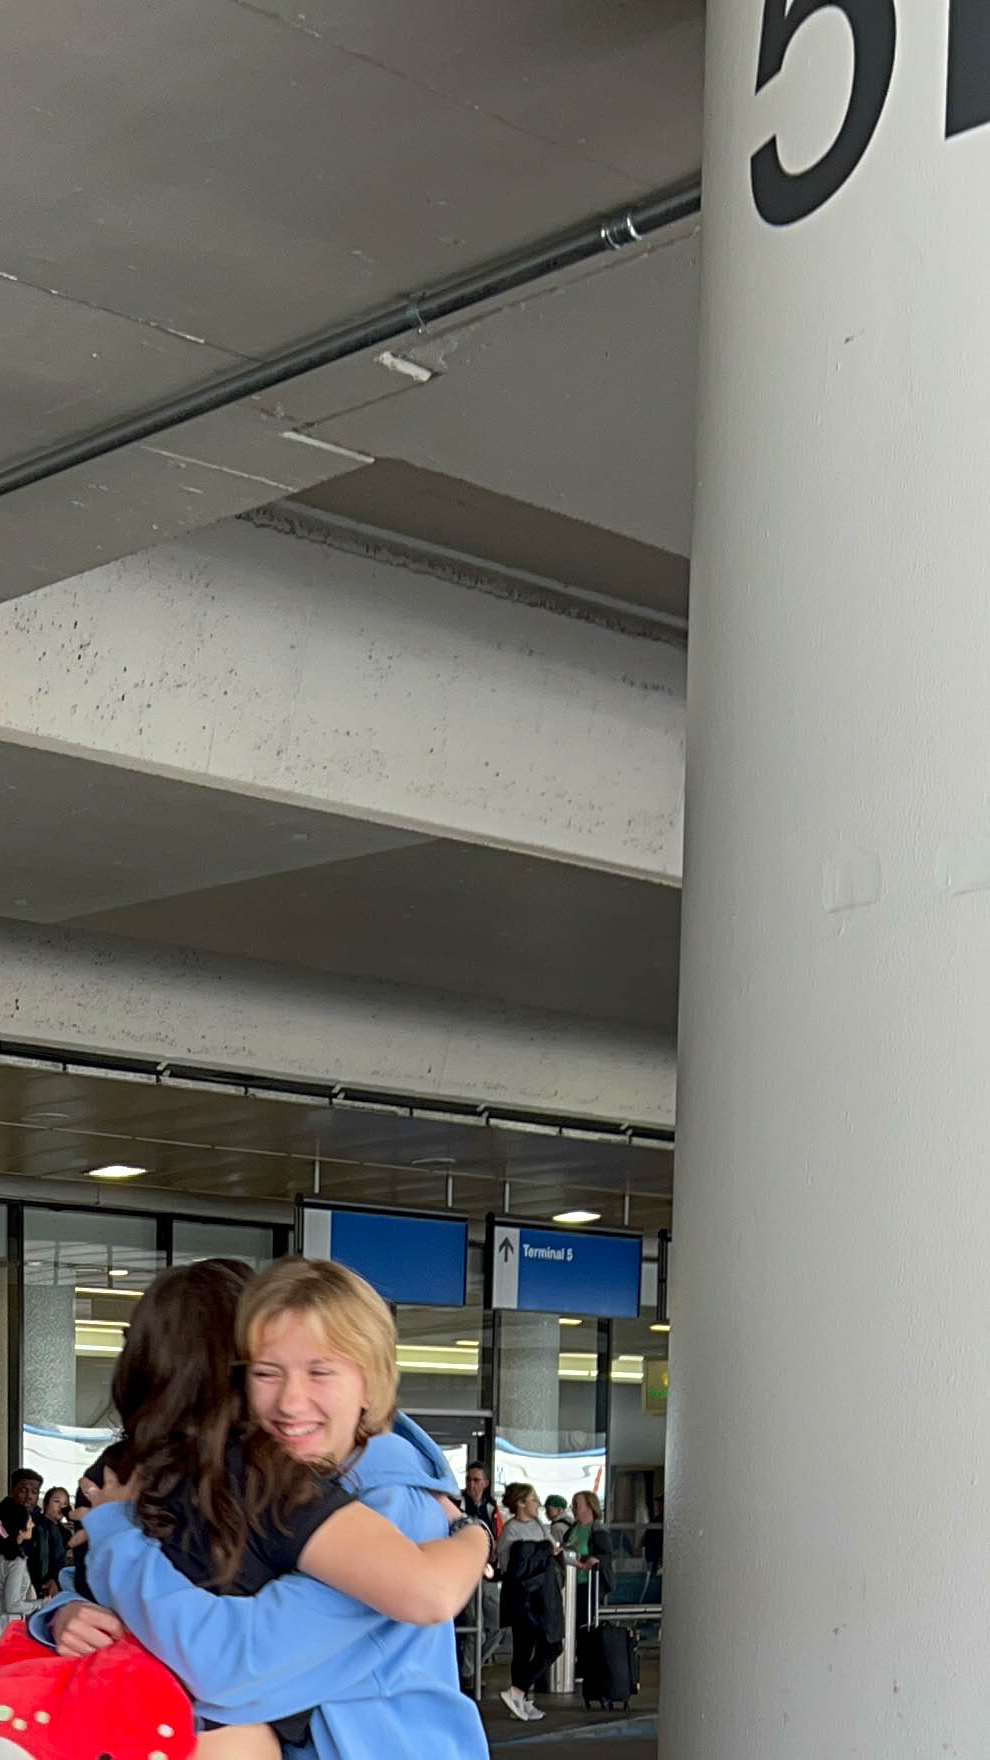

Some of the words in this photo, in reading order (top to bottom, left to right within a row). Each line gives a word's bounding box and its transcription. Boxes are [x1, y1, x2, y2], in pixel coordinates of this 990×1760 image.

[750, 0, 990, 227] 5
[522, 1244, 565, 1260] Terminal
[566, 1248, 574, 1262] 5
